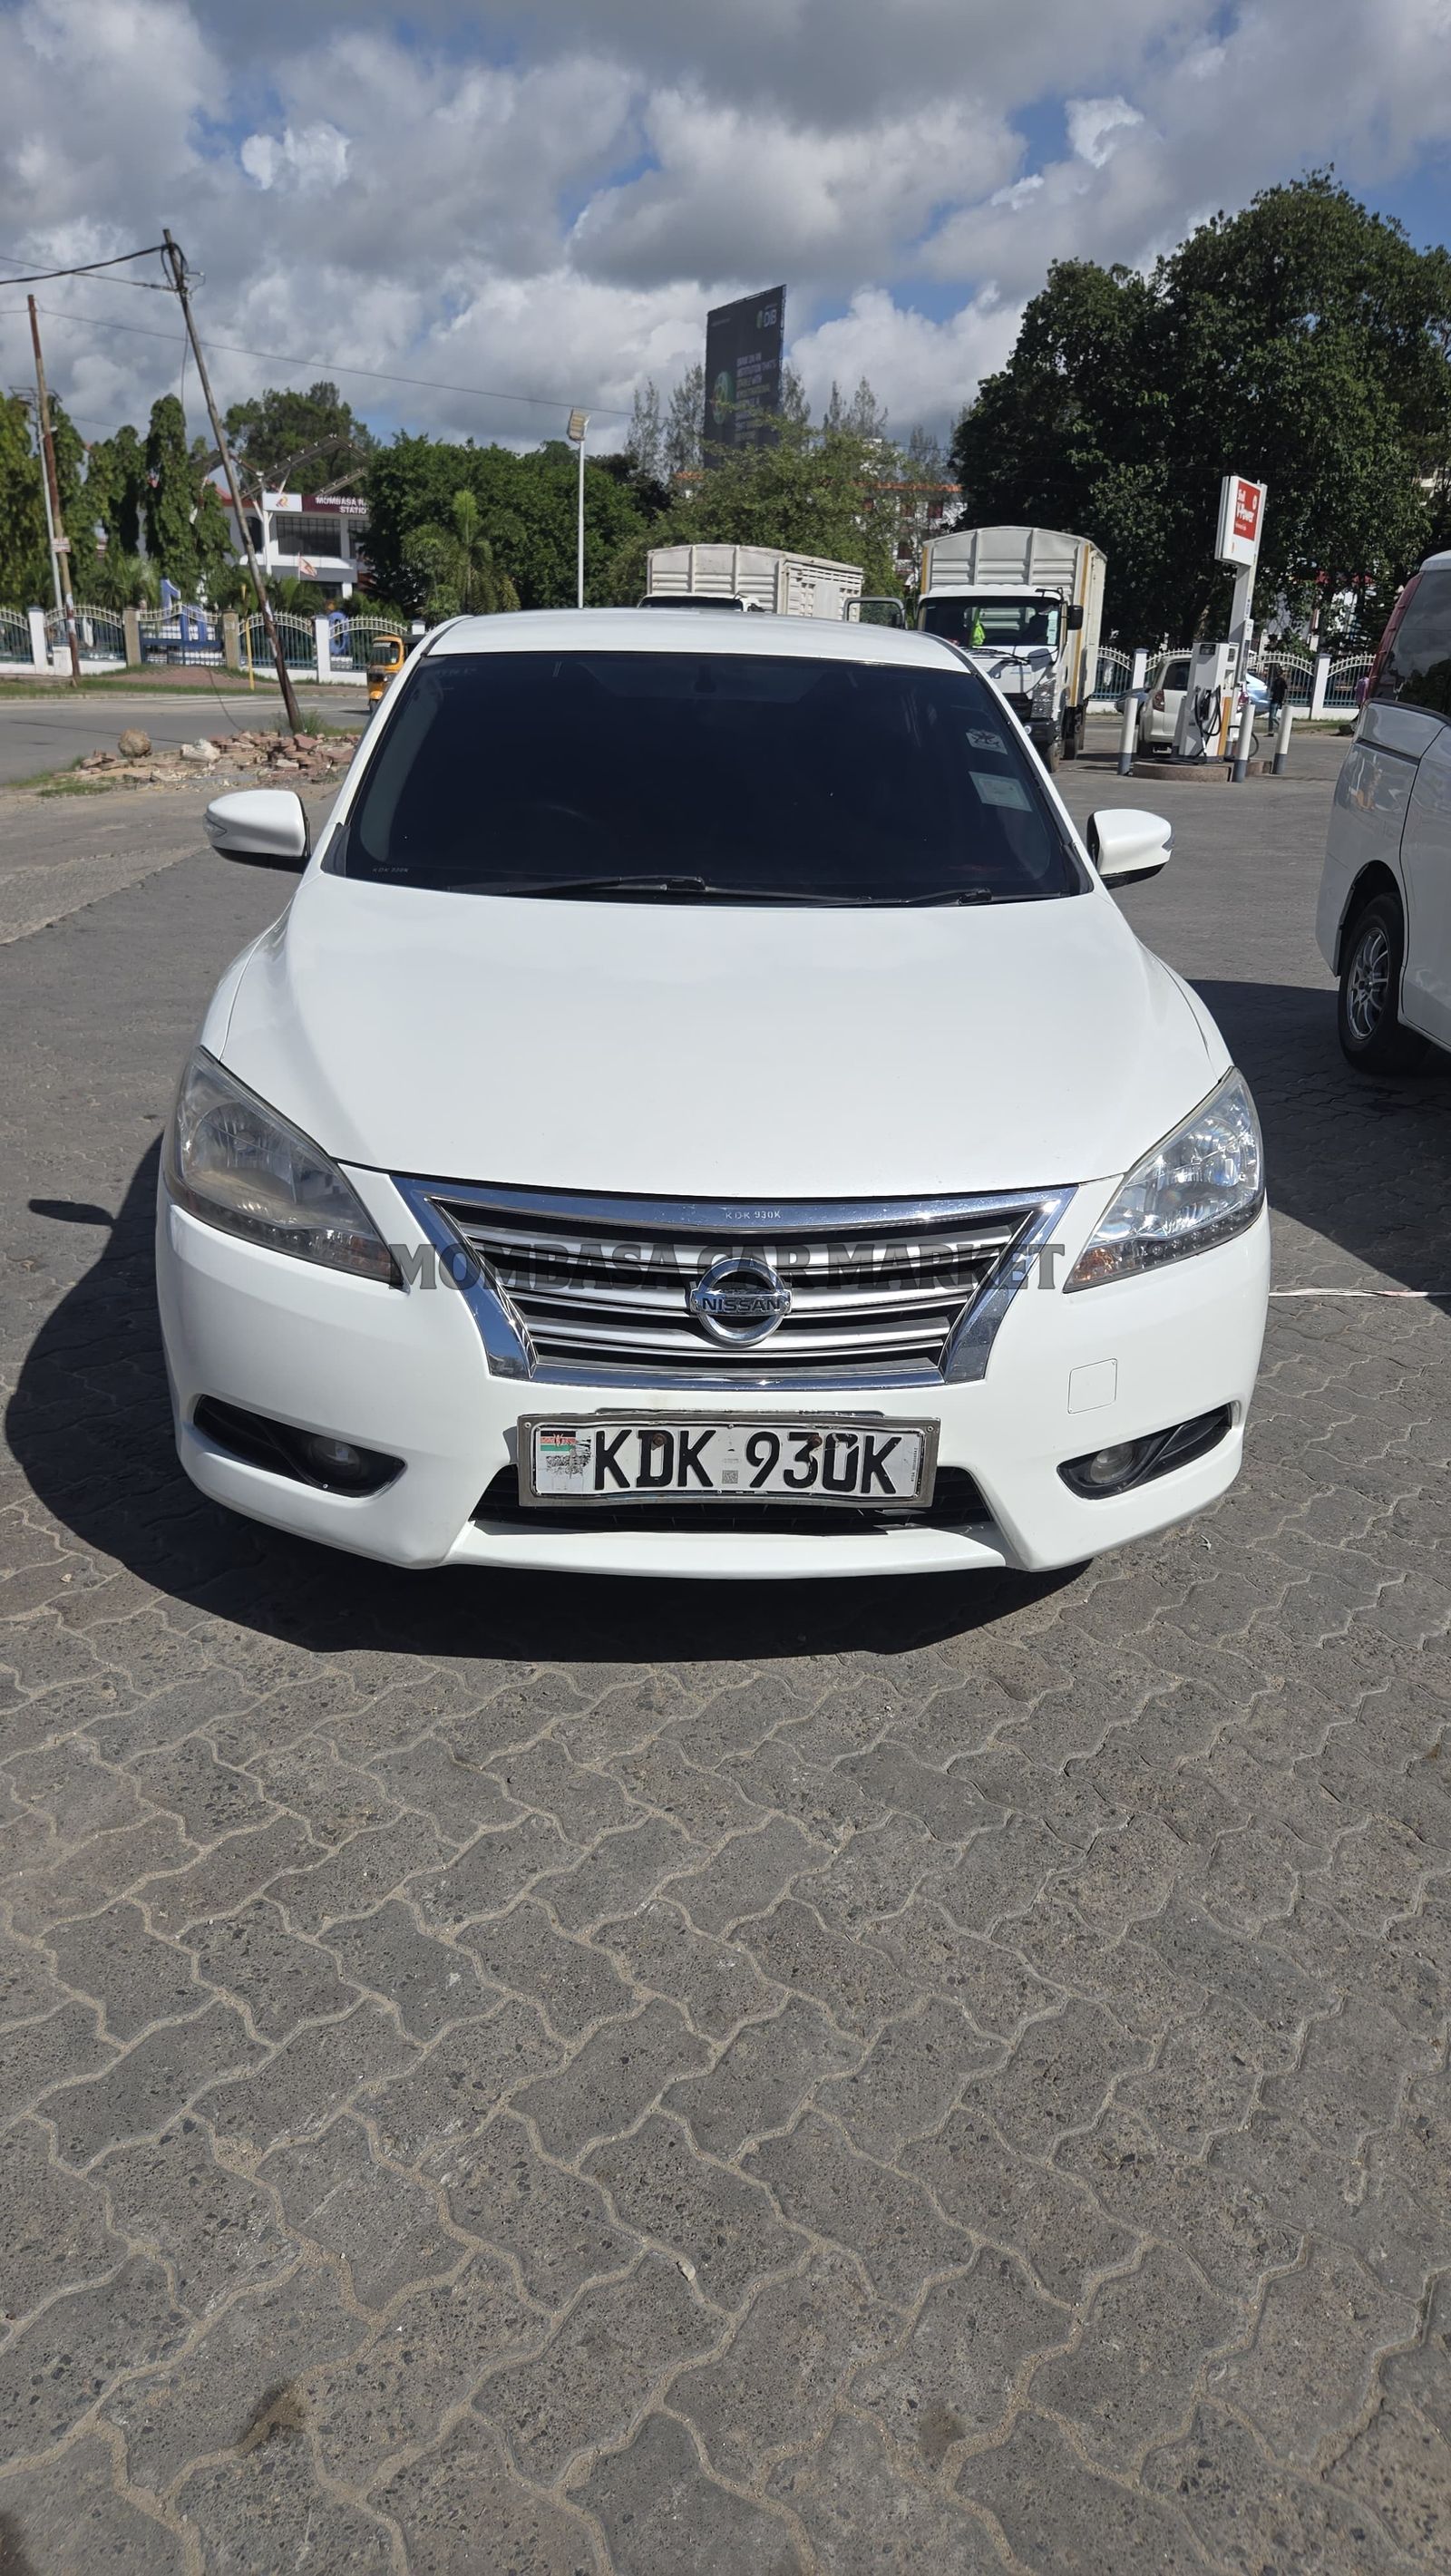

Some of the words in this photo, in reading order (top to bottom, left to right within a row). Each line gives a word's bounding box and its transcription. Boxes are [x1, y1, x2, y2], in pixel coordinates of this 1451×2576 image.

[315, 497, 356, 506] MOMBASA
[755, 1210, 781, 1219] 930K
[702, 1298, 781, 1312] NISSAN
[594, 1429, 716, 1491] KDK
[745, 1431, 902, 1494] 930K
